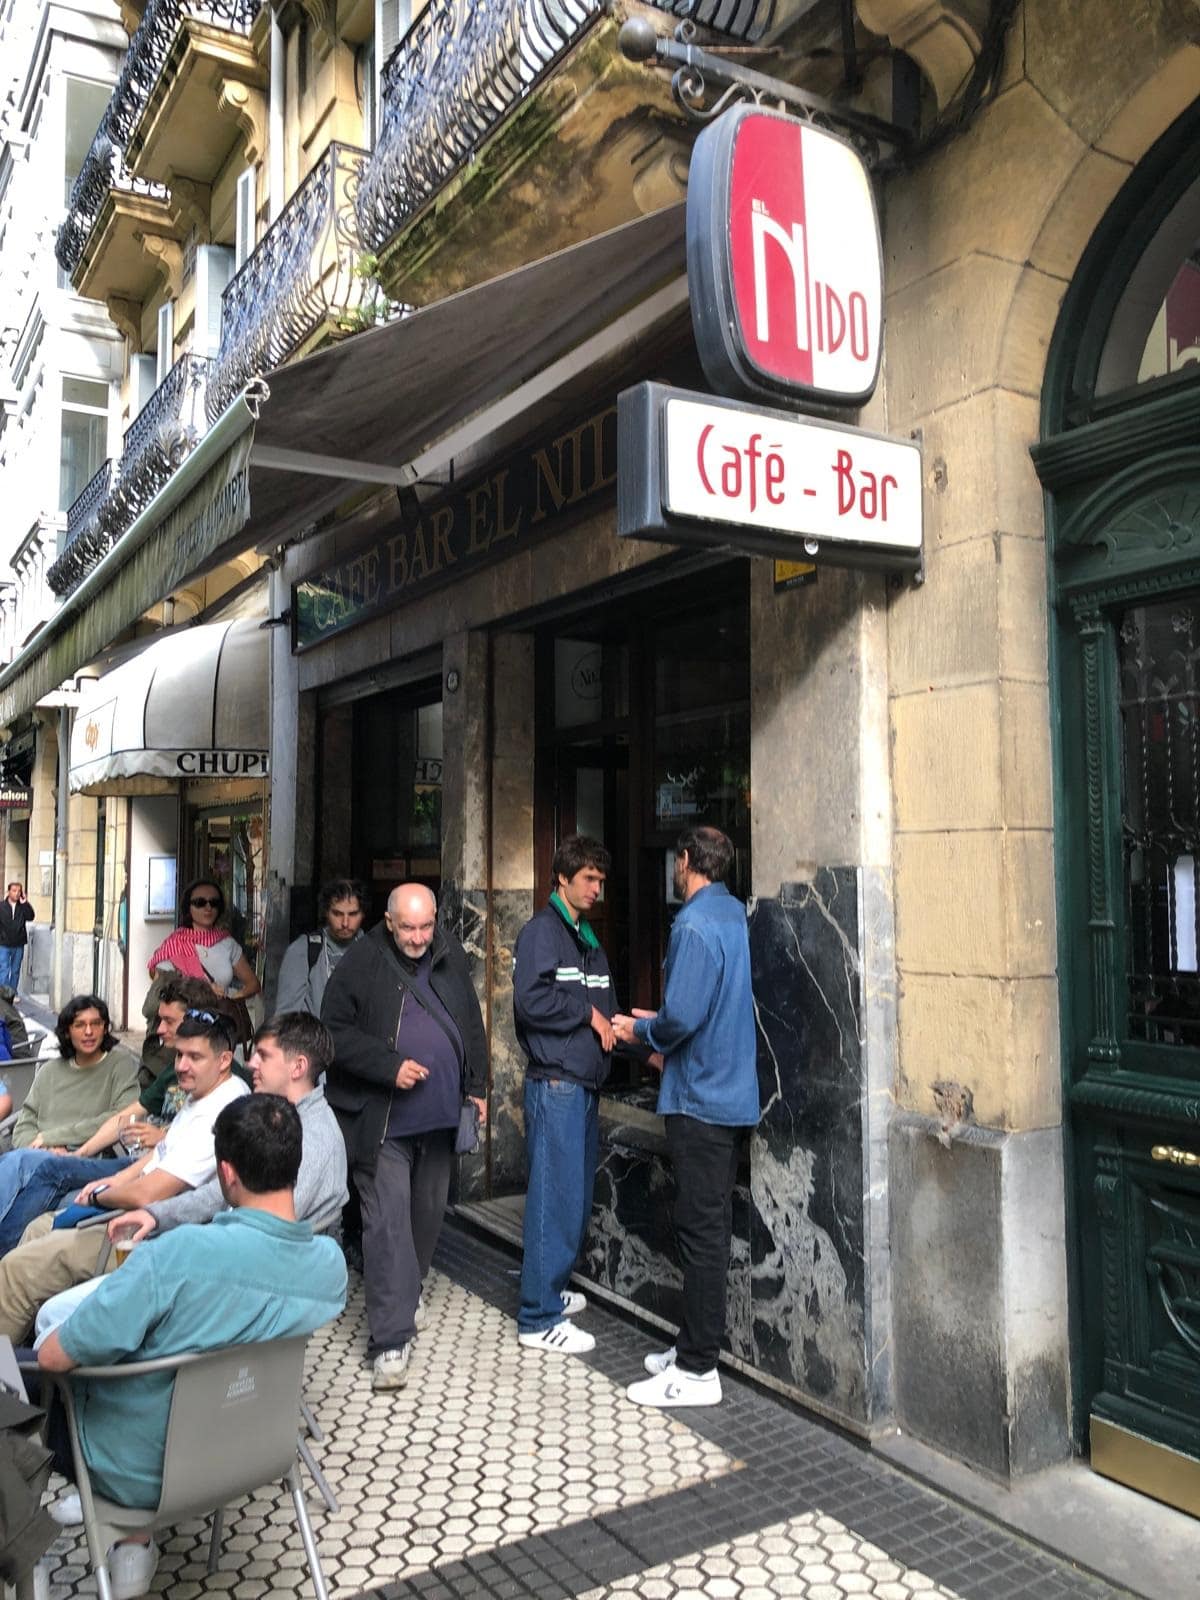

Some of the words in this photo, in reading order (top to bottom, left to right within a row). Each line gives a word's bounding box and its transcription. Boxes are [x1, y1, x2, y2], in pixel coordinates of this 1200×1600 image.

[751, 198, 770, 217] EL
[751, 211, 869, 362] NIDO
[697, 424, 785, 513] Café
[831, 449, 898, 522] Bar
[313, 545, 381, 631] CAFE
[386, 505, 458, 594] BAR
[465, 468, 522, 555] EL
